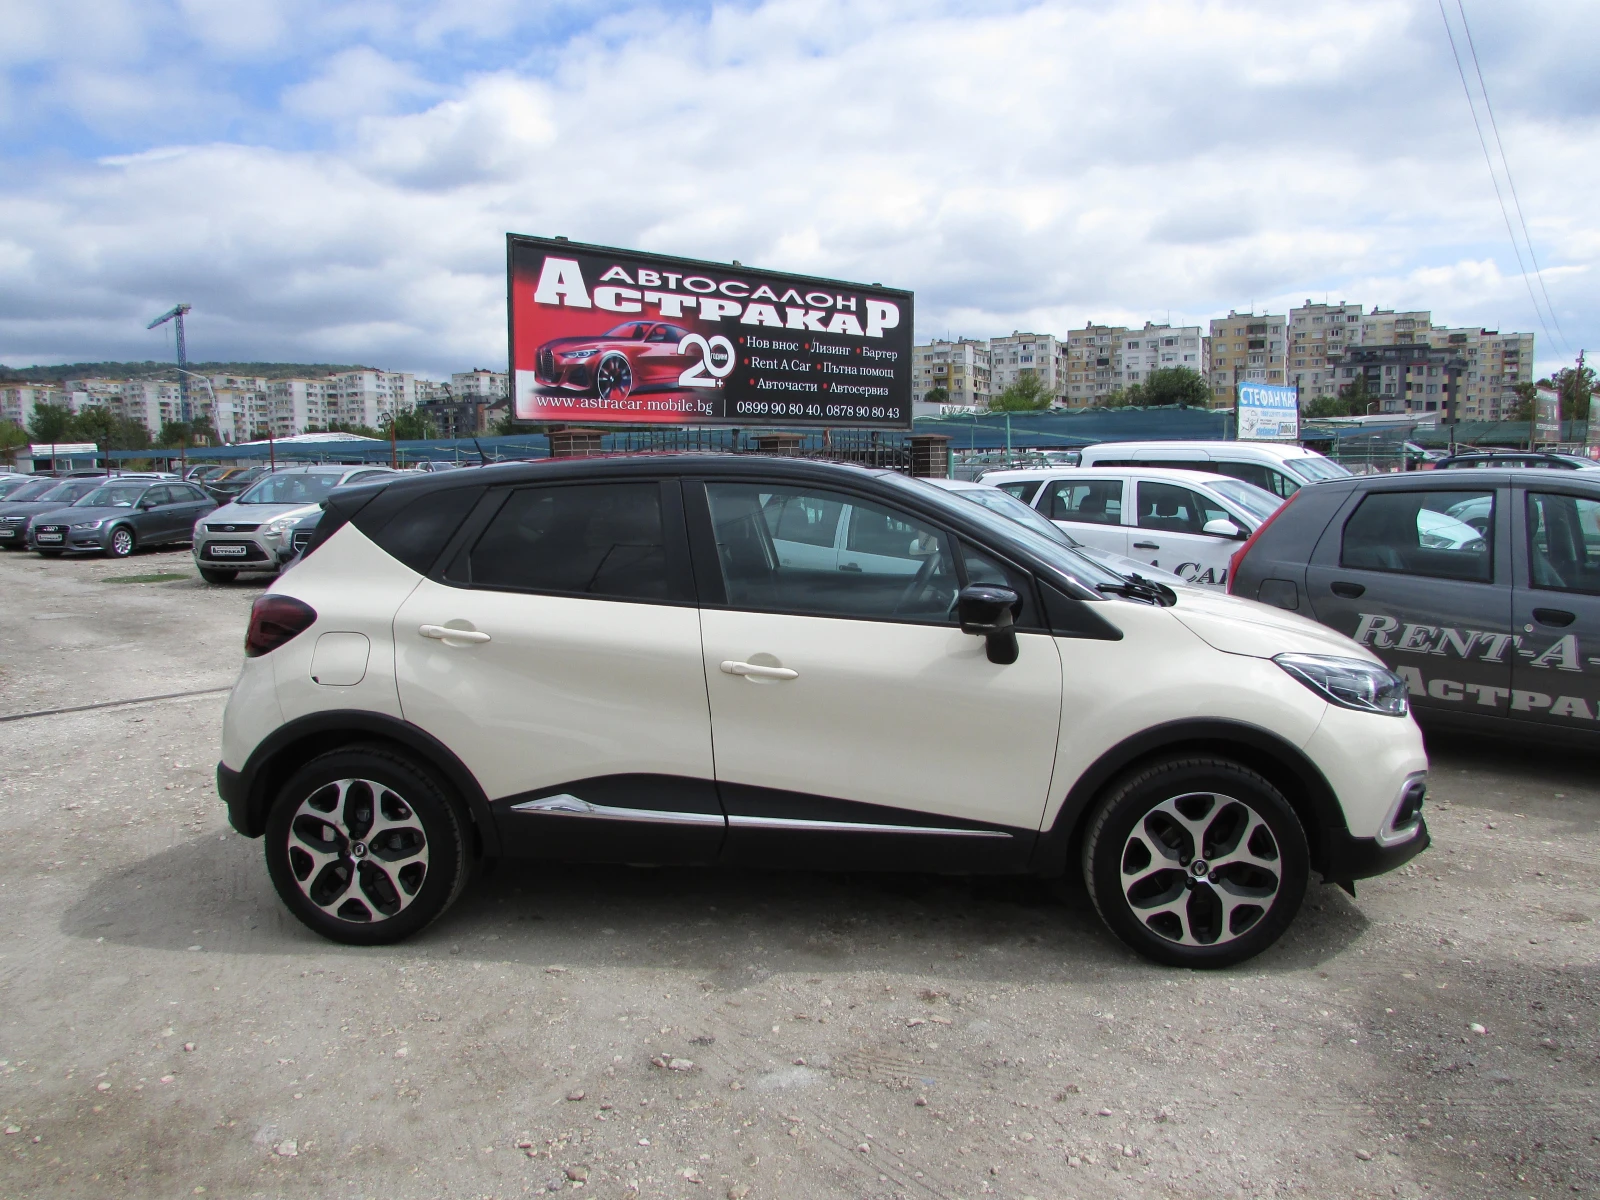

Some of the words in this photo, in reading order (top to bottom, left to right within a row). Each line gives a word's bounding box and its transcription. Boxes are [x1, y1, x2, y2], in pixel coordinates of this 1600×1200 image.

[599, 265, 858, 311] АВТОСАЛОН
[534, 256, 900, 338] АСТРАКАР
[746, 335, 770, 349] Нов
[772, 340, 800, 352] внос
[810, 340, 852, 356] Лизинг
[862, 346, 899, 362] Бартер
[751, 357, 779, 370] Rent
[780, 359, 790, 371] A
[791, 360, 812, 372] Car
[823, 362, 858, 375] Пътна
[859, 366, 896, 380] помощ
[756, 378, 819, 393] Авточасти
[829, 382, 890, 398] Автосервиз
[1240, 387, 1281, 406] СТЕФАН
[536, 395, 714, 416] www.astracar.mobile.bg
[737, 401, 769, 414] 0899
[770, 402, 786, 415] 90
[788, 403, 804, 416] 80
[826, 405, 854, 417] 0878
[856, 406, 870, 418] 90
[871, 407, 885, 418] 80
[886, 407, 901, 419] 43
